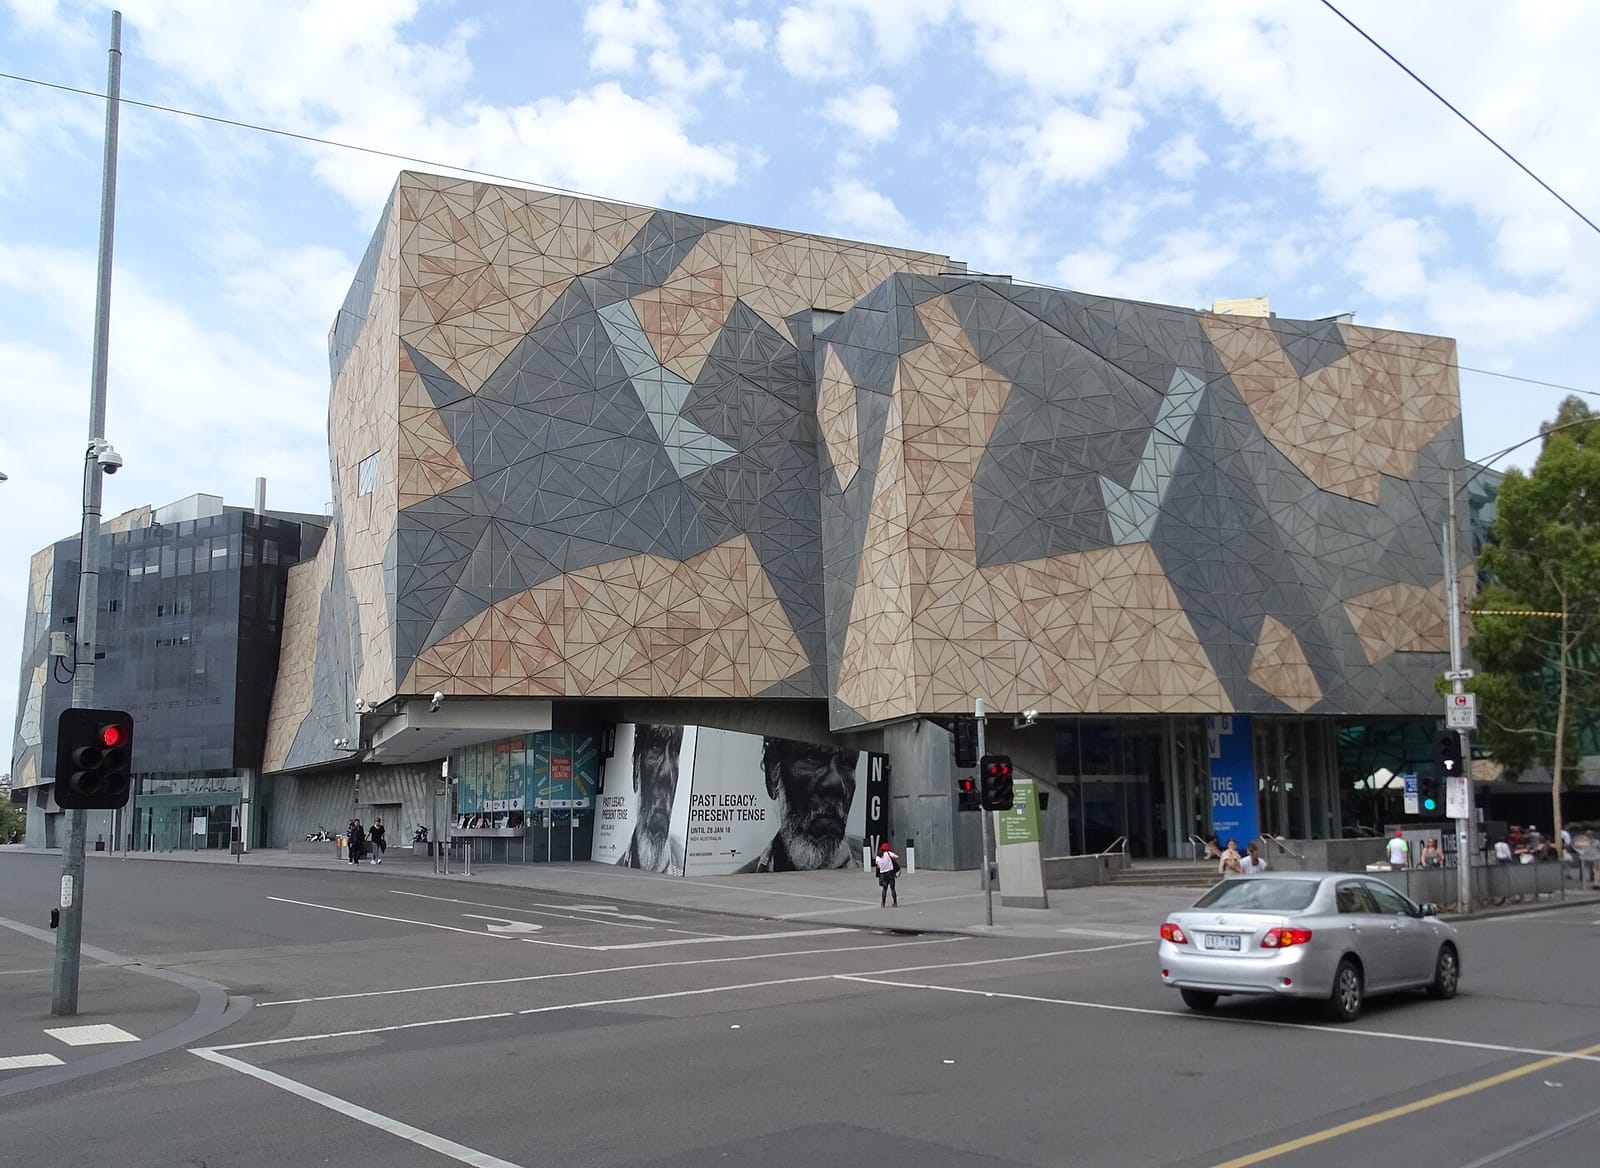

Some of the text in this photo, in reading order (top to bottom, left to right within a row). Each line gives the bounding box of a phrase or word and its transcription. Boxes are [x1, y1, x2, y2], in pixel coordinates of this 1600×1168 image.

[1211, 777, 1233, 791] THE
[692, 794, 757, 807] PAST LEGACY:
[1213, 792, 1243, 807] POOL
[691, 809, 766, 822] PRESENT TENSE
